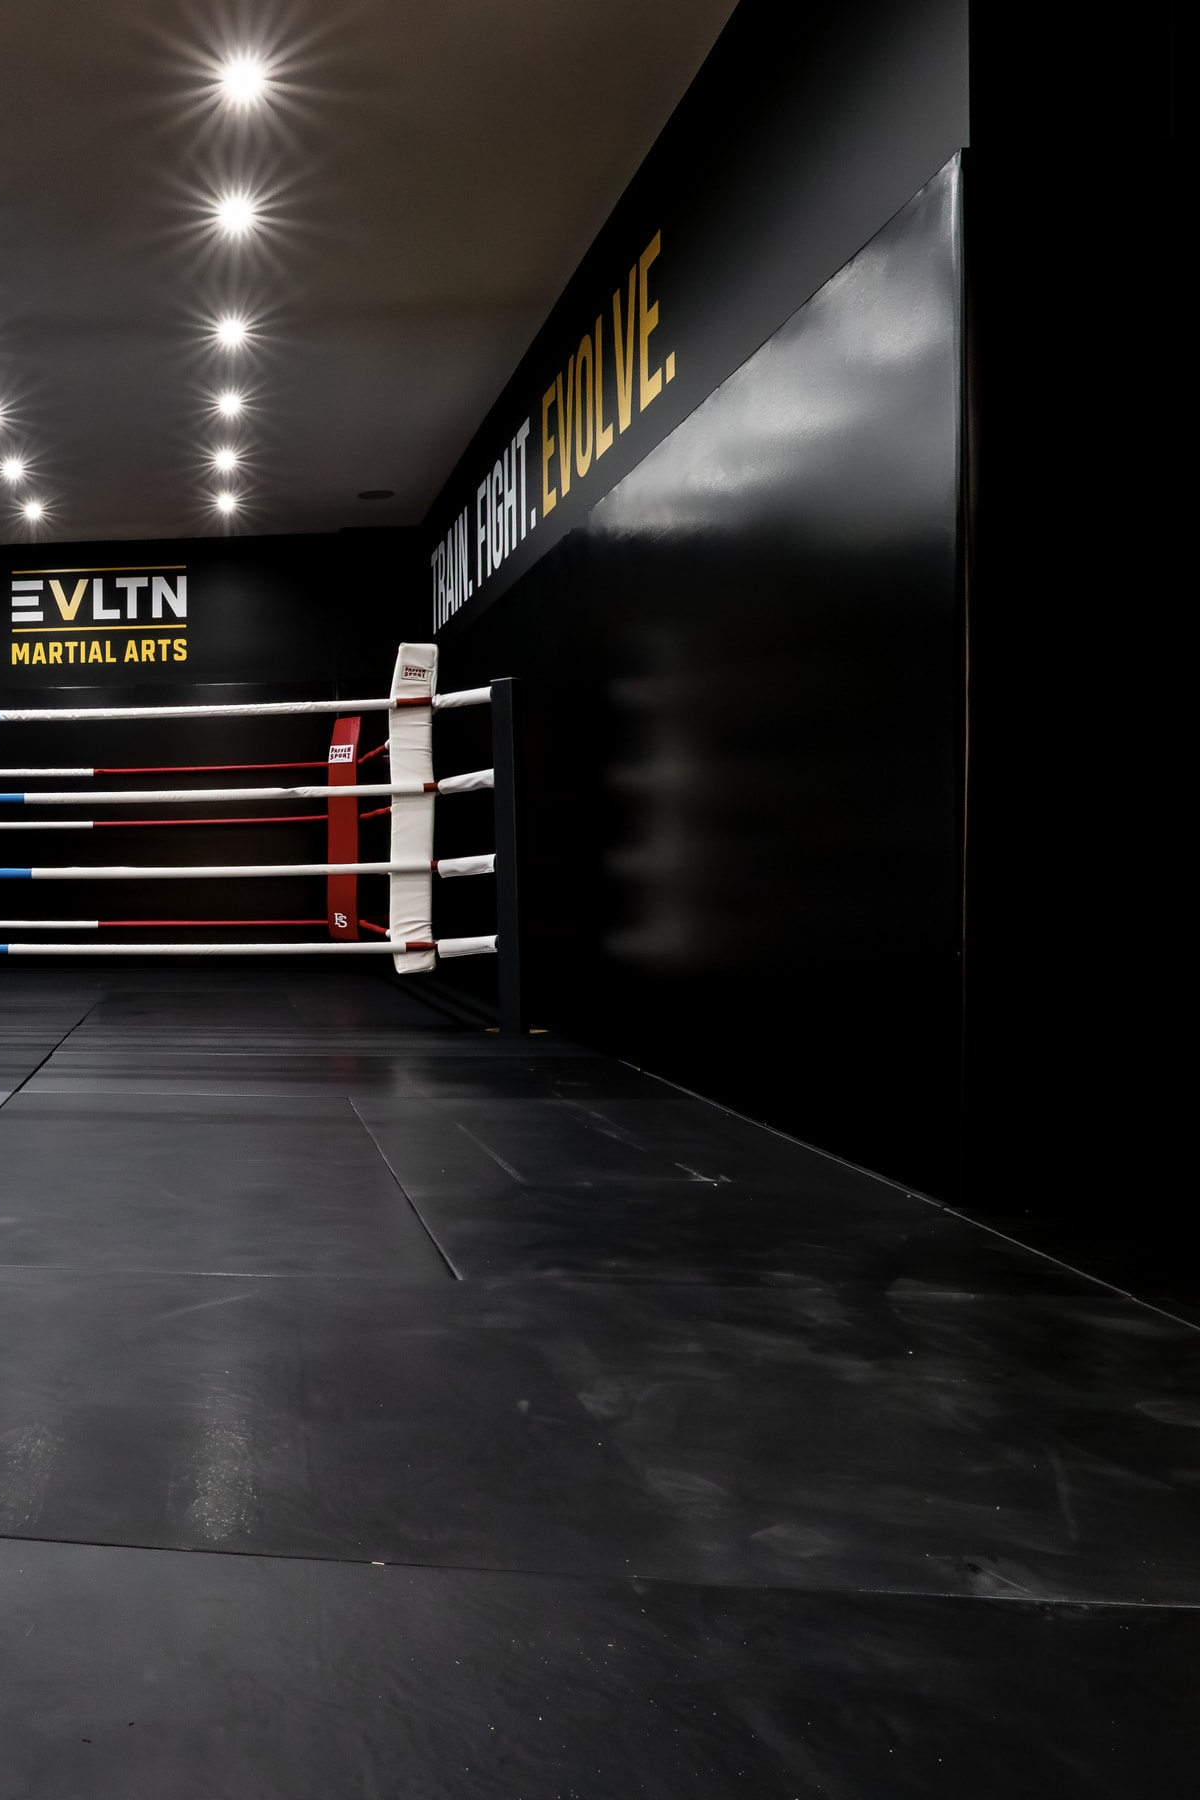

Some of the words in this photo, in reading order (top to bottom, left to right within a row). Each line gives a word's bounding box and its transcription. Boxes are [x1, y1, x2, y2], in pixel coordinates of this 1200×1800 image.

[430, 505, 474, 636] TRAIN.
[476, 416, 537, 588] FIGHT.
[540, 228, 676, 519] EVOLVE.
[11, 576, 187, 622] EVLTN
[11, 640, 117, 665] MARTIAL
[124, 638, 187, 662] ARTS
[330, 753, 351, 761] SPORT
